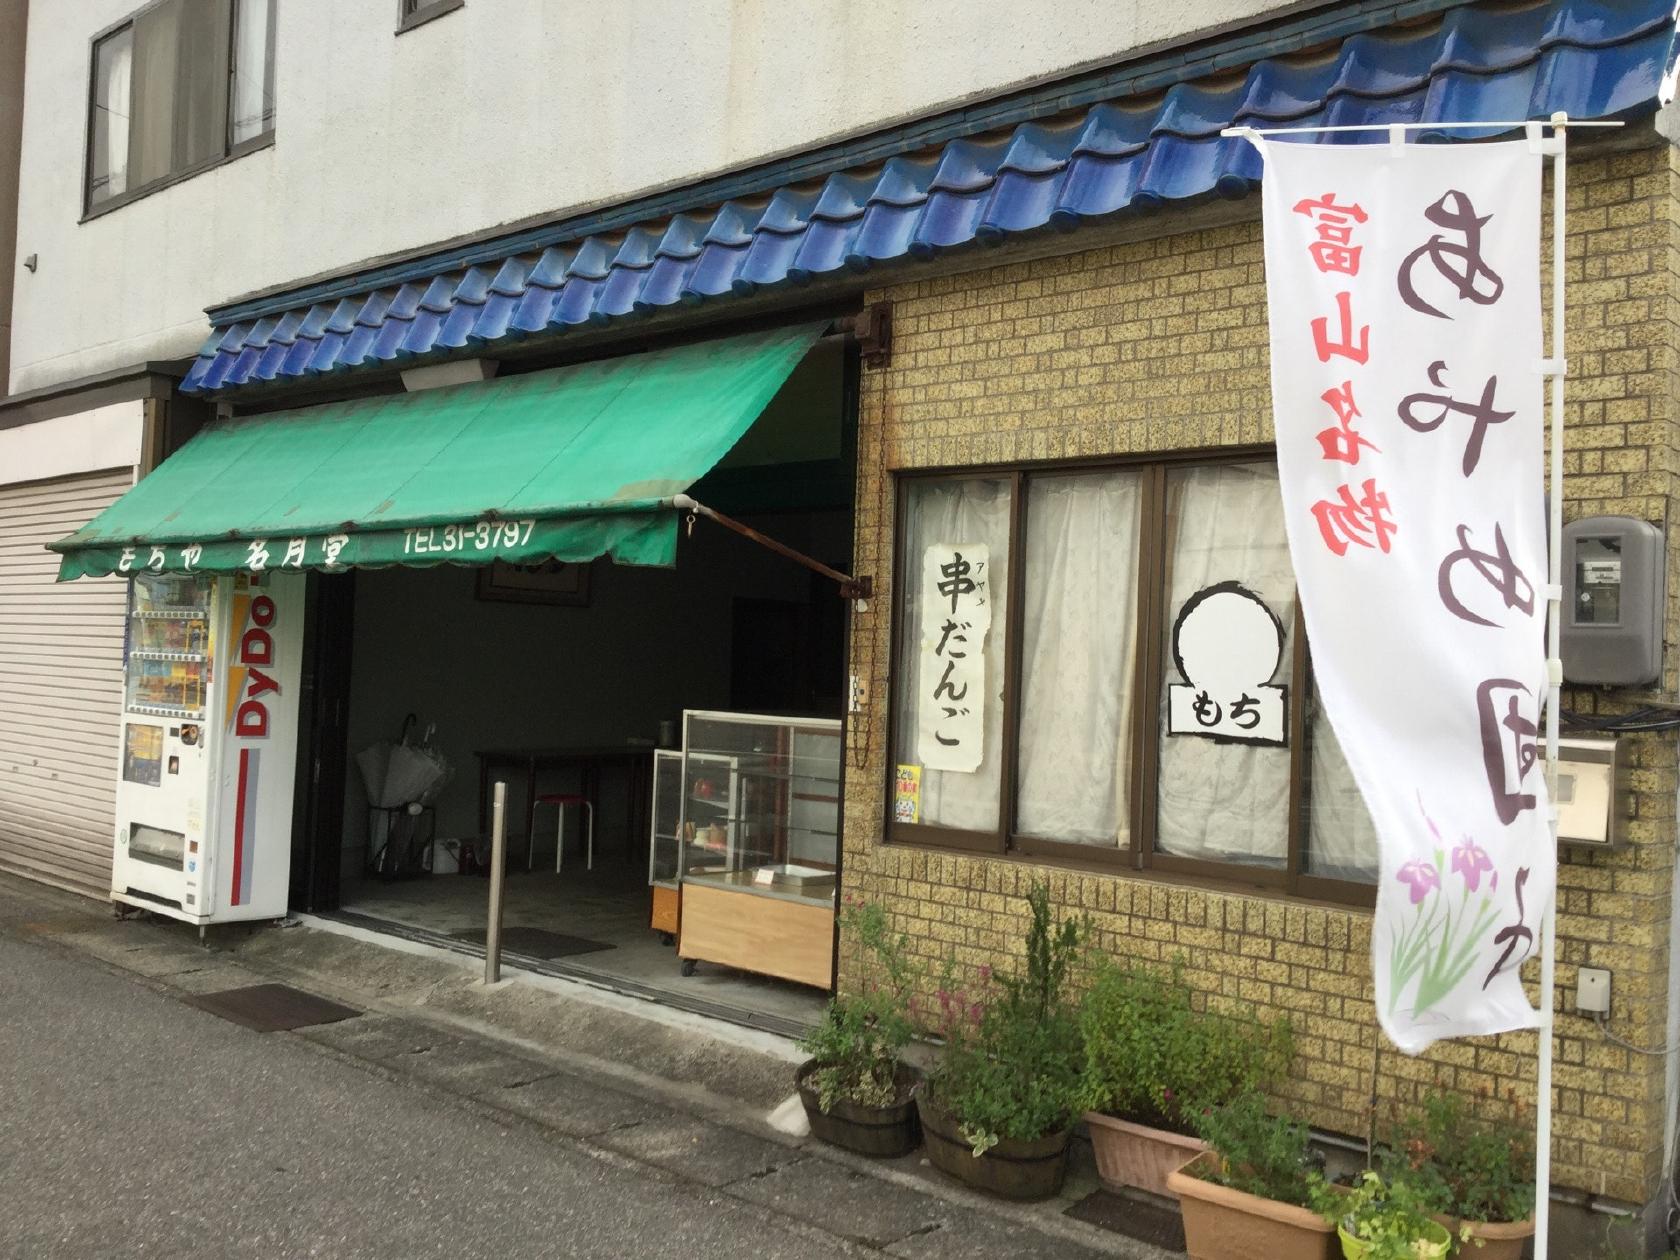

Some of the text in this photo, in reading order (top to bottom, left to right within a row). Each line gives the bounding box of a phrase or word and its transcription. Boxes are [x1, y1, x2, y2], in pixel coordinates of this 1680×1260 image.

[244, 533, 350, 571] 名月堂
[235, 594, 280, 738] DyDo
[932, 551, 977, 747] 串だんご
[1191, 690, 1262, 730] もち
